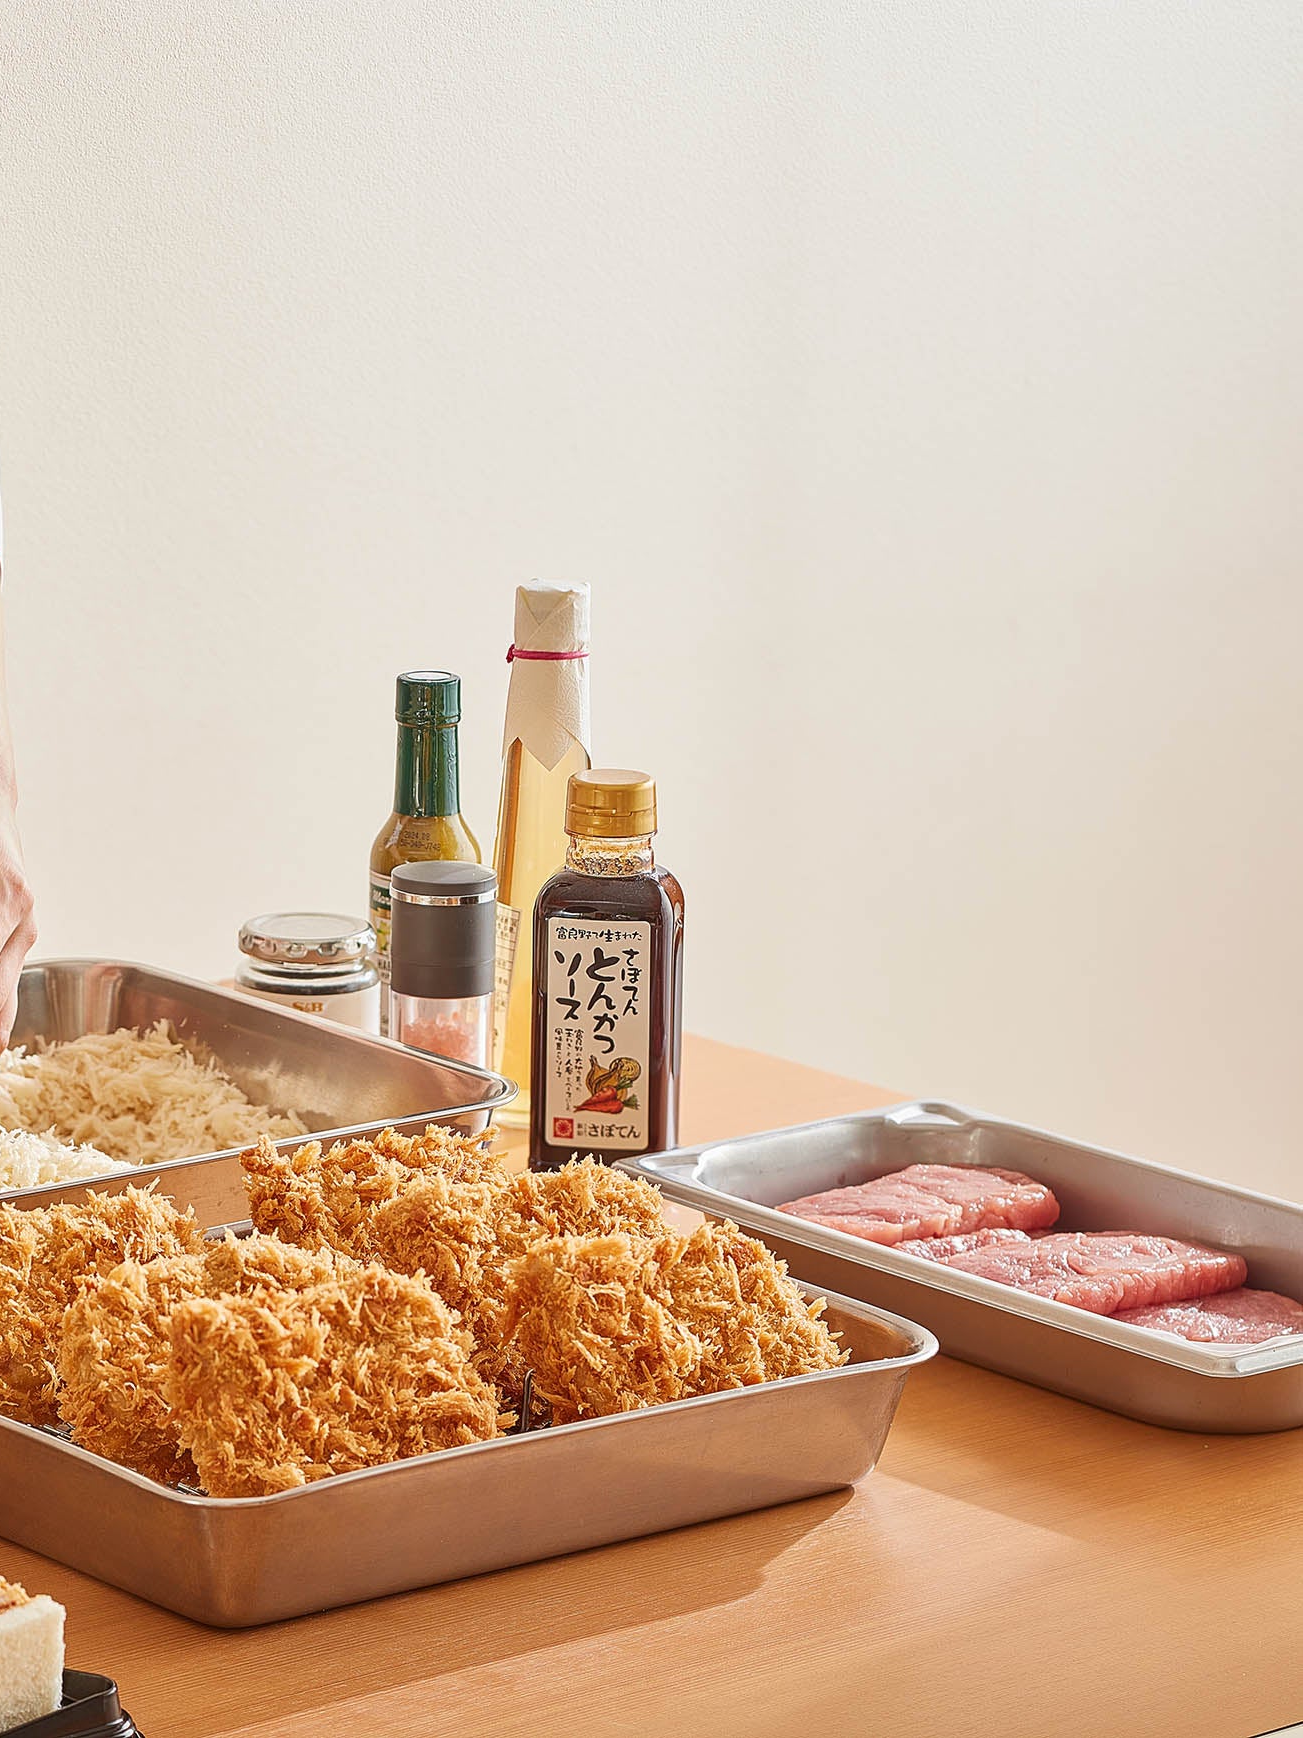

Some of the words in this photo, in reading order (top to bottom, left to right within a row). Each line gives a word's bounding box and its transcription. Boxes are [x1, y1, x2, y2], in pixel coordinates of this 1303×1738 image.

[555, 926, 642, 943] 富良野で生まれた
[554, 950, 582, 1020] ソース
[586, 947, 620, 1054] とんかつ
[621, 948, 642, 1016] さぼてん
[292, 1001, 324, 1013] S&B
[588, 1123, 641, 1138] さぼてん
